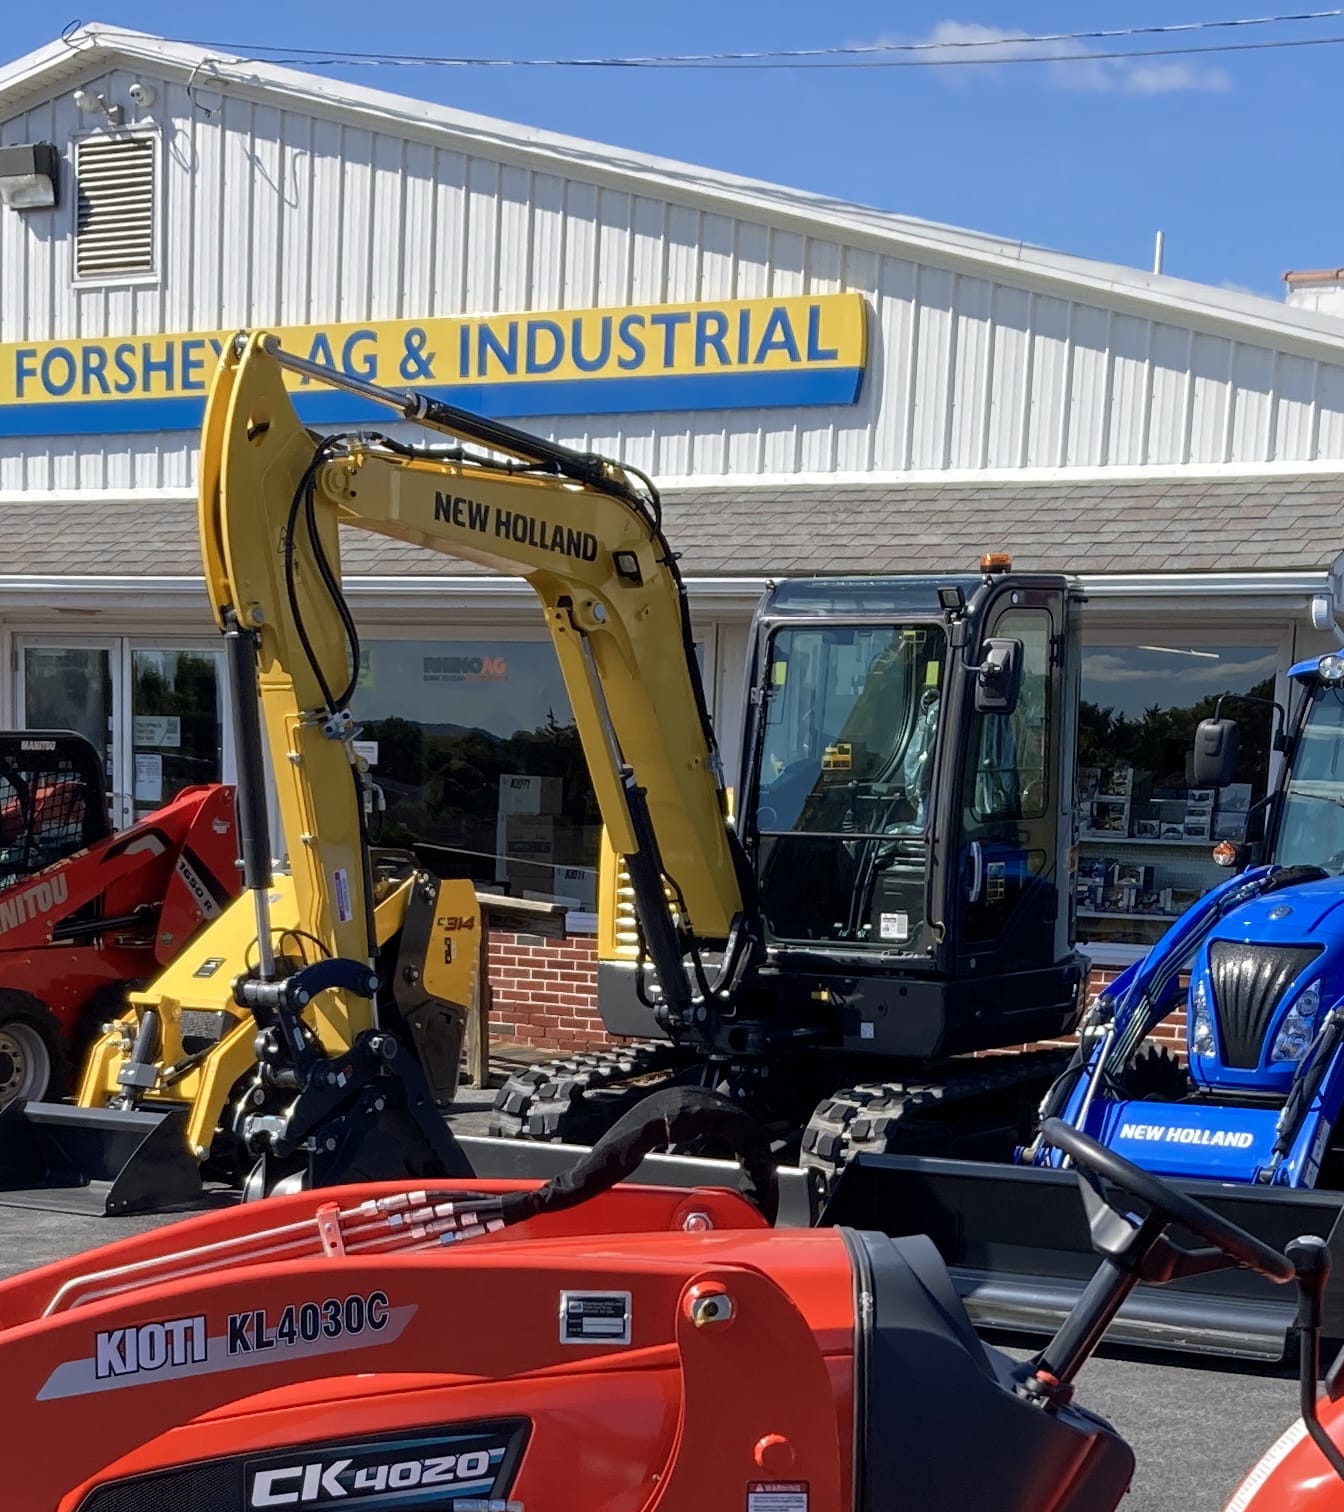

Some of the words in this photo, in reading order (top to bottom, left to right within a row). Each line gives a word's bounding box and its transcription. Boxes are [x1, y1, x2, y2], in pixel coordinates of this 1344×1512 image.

[15, 338, 224, 398] FORSHE
[399, 327, 438, 381] &
[459, 304, 839, 378] INDUSTRIAL
[434, 490, 490, 533] NEW
[495, 507, 598, 562] HOLLAND
[20, 740, 56, 751] MANITOU
[179, 861, 204, 898] 1650
[204, 899, 213, 912] R
[1119, 1123, 1166, 1141] NEW
[1165, 1126, 1254, 1148] HOLLAND
[95, 1313, 207, 1379] KIOTI
[227, 1290, 389, 1356] KL4030C
